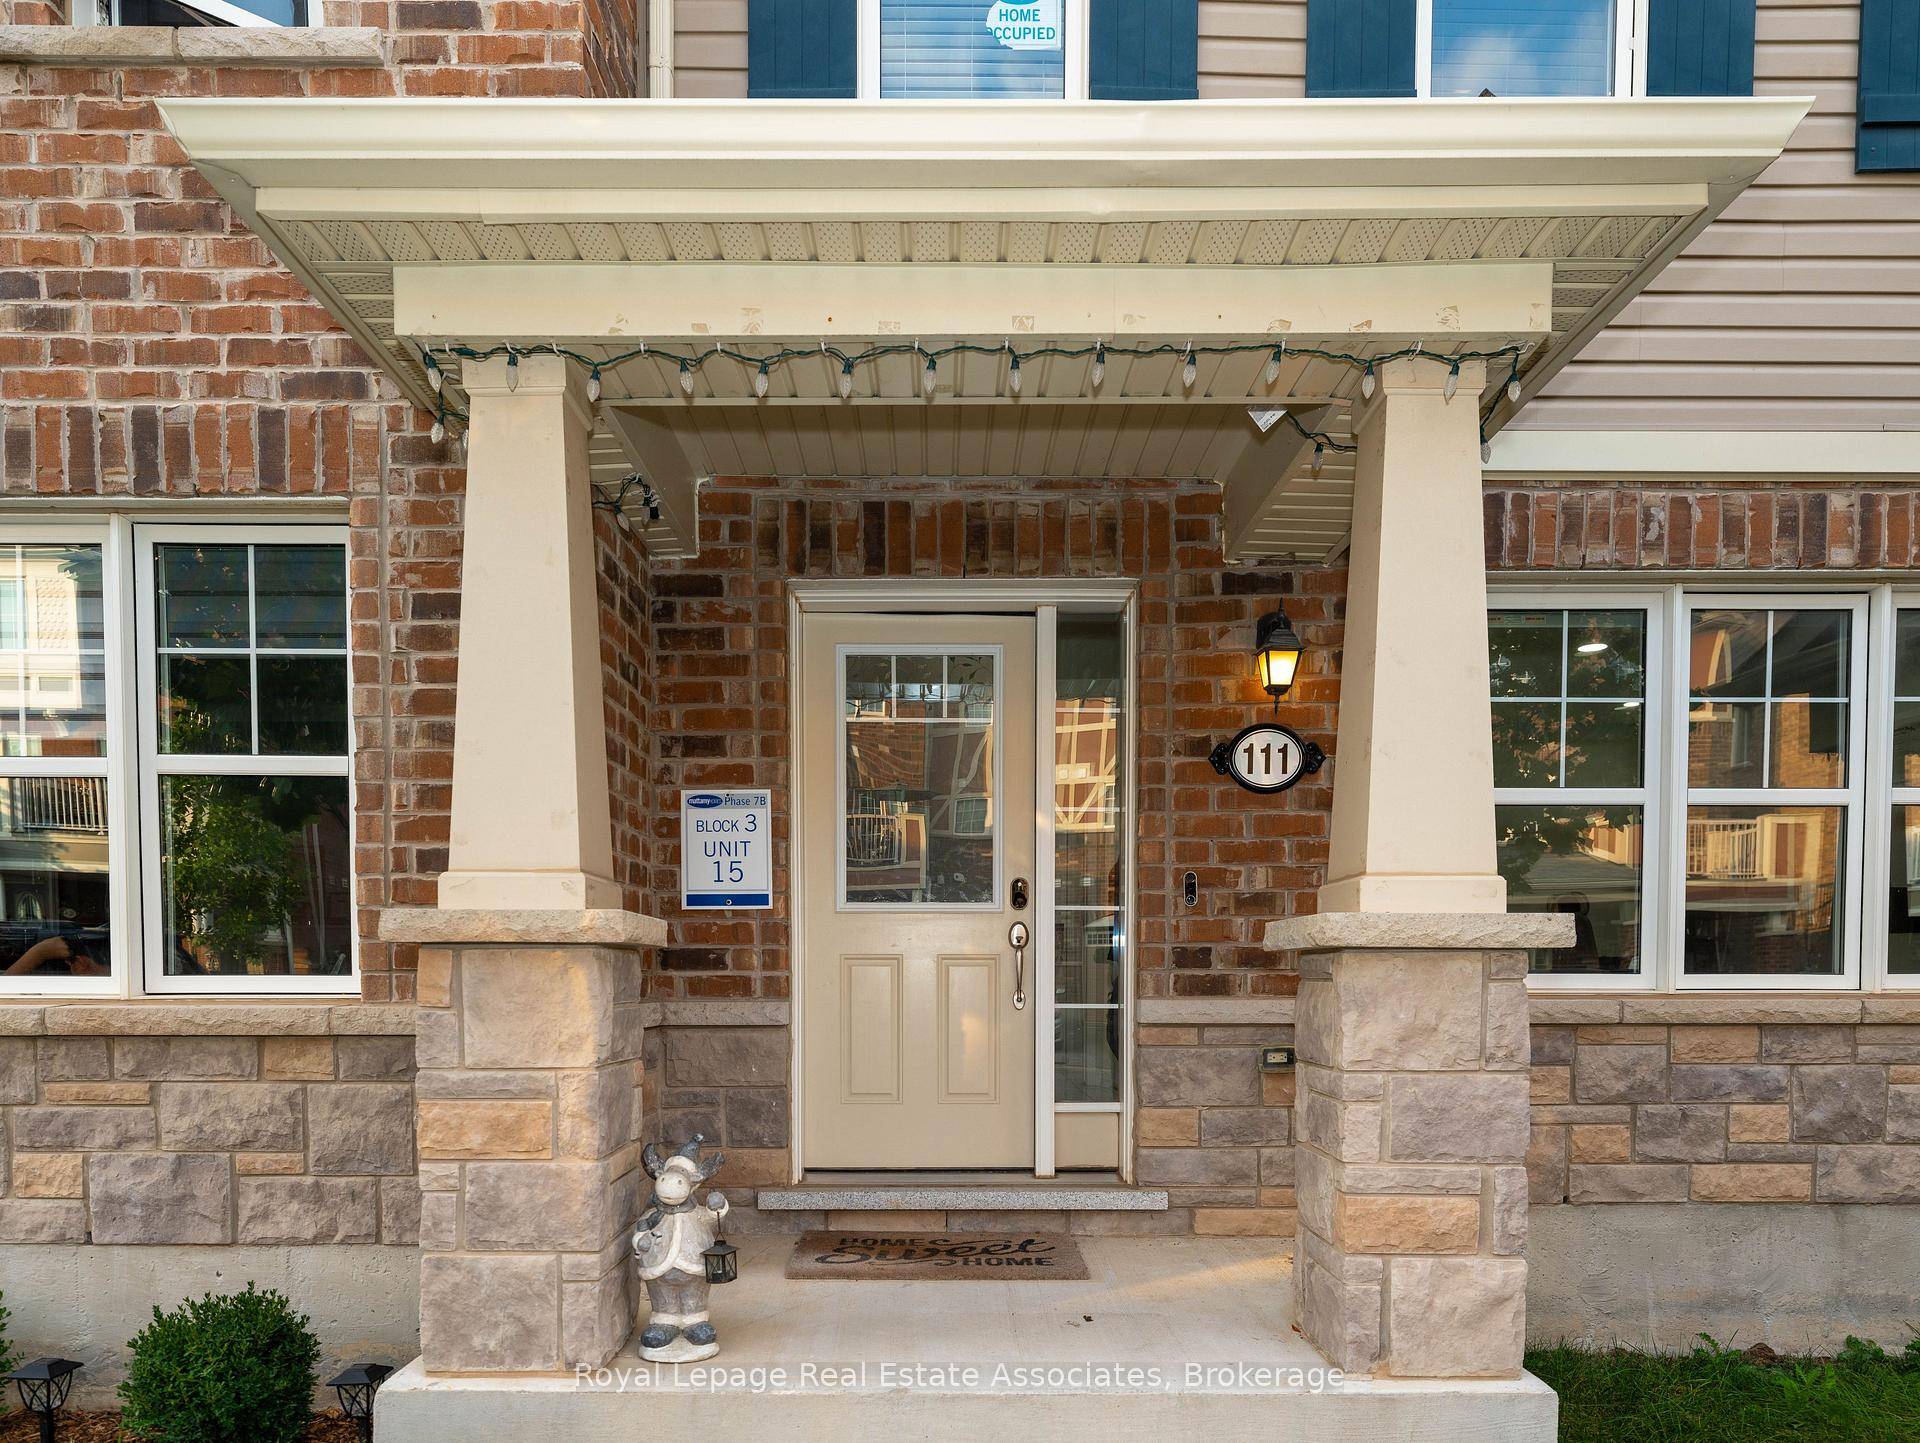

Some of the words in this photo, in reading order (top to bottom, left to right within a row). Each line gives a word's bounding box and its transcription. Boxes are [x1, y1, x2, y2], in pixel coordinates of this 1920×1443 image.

[999, 9, 1040, 22] HOME
[1243, 743, 1288, 775] 111
[724, 796, 751, 806] Phase
[753, 796, 767, 806] 7B
[696, 820, 740, 833] BLOCK
[744, 814, 757, 833] 3
[704, 841, 751, 857] UNIT
[713, 861, 744, 883] 15
[839, 1238, 926, 1247] HOME
[961, 1257, 1055, 1267] HOME
